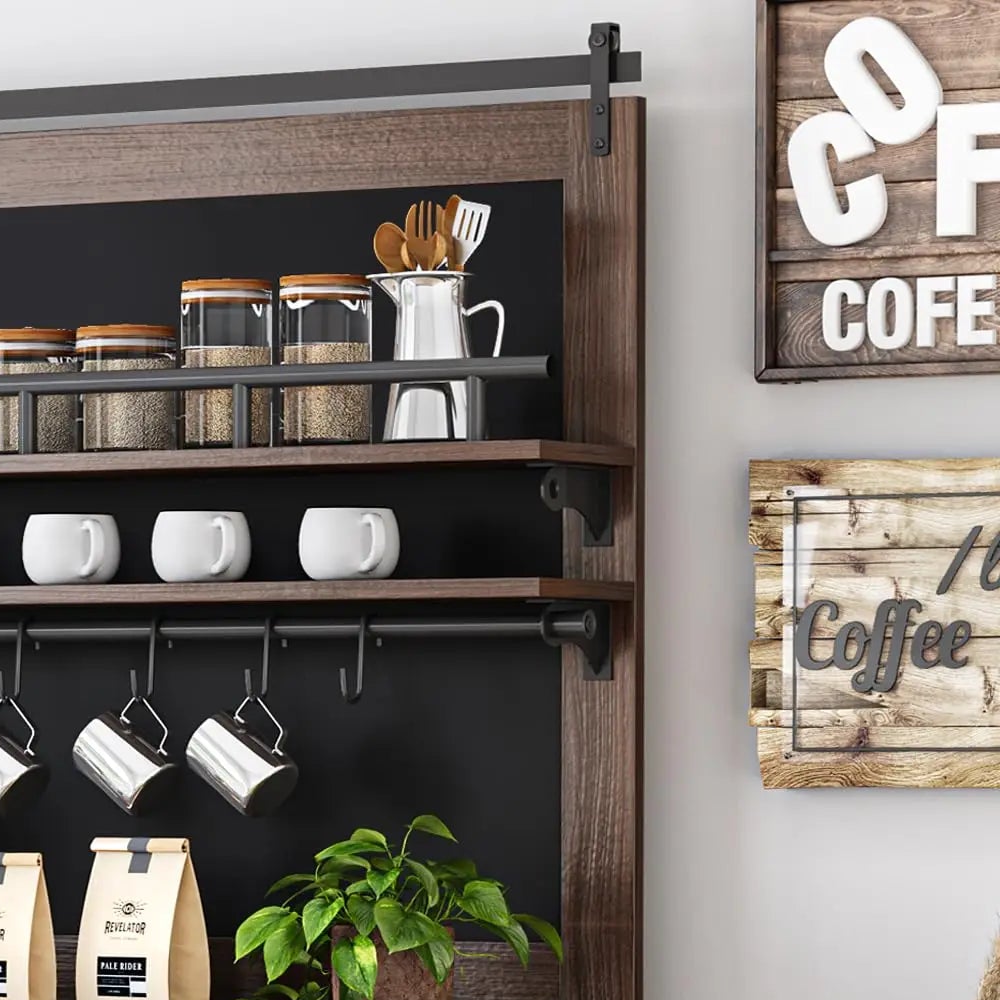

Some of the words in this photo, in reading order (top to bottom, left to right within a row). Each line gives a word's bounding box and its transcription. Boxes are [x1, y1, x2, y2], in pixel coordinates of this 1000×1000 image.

[822, 274, 998, 352] COFE
[794, 598, 972, 693] Coffee
[103, 920, 147, 936] REVELATOR
[100, 961, 119, 971] PALE
[120, 961, 143, 971] RIDER
